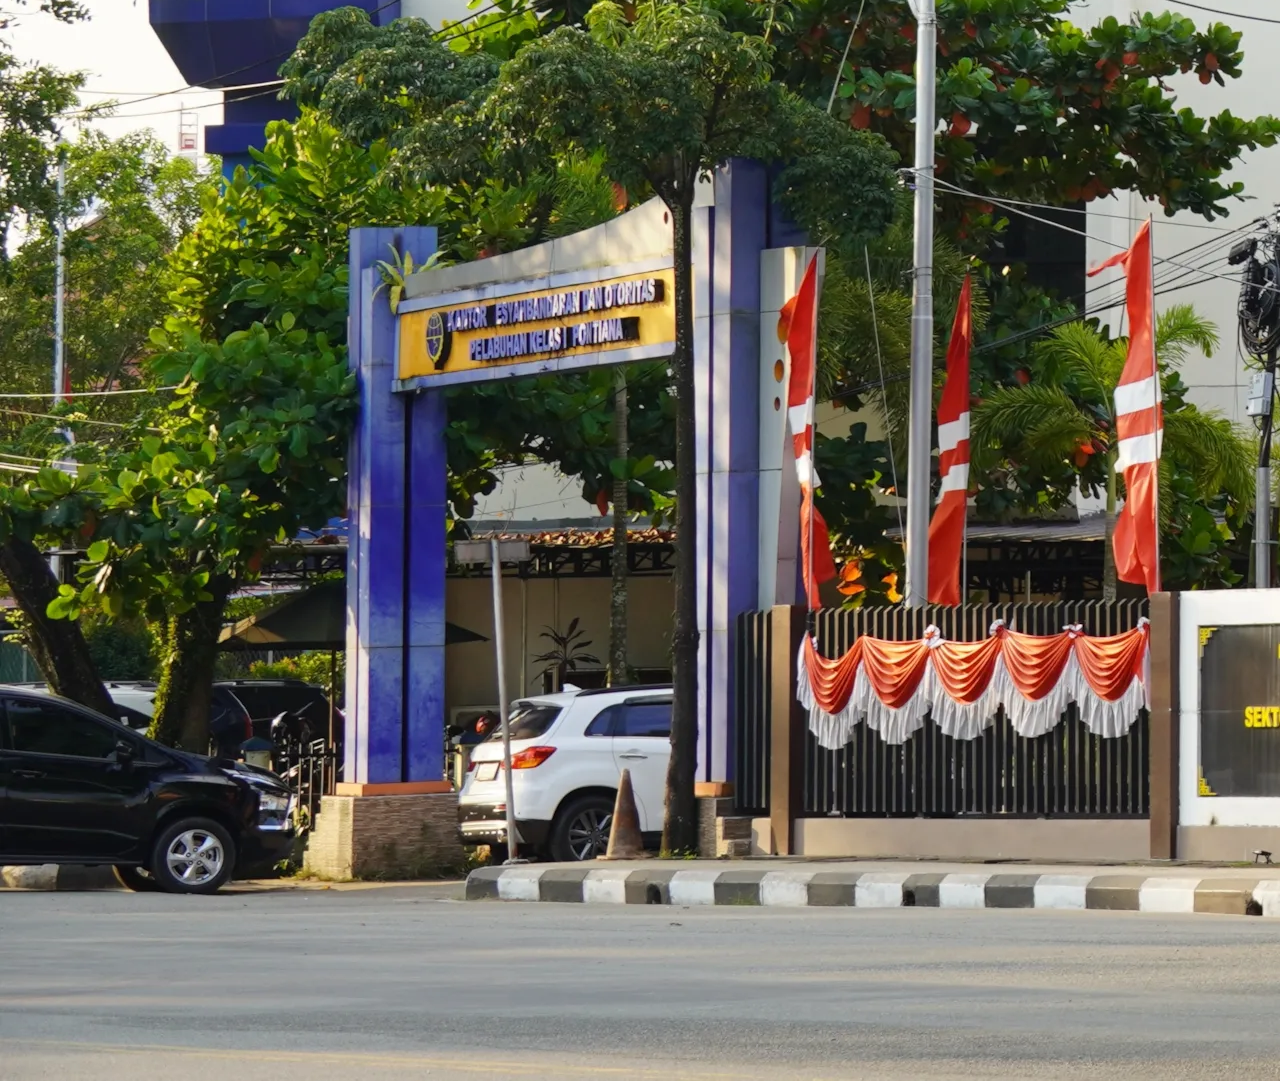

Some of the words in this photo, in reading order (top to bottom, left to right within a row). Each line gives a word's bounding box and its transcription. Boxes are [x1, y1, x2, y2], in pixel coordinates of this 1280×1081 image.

[447, 306, 487, 332] KANTOR
[489, 291, 580, 325] ESYAHBANDARAN
[582, 286, 601, 311] DAN
[604, 278, 655, 307] OTORITAS
[470, 333, 527, 360] PELABUHAN
[530, 326, 561, 353] KELAS
[572, 318, 629, 347] PONTIANA
